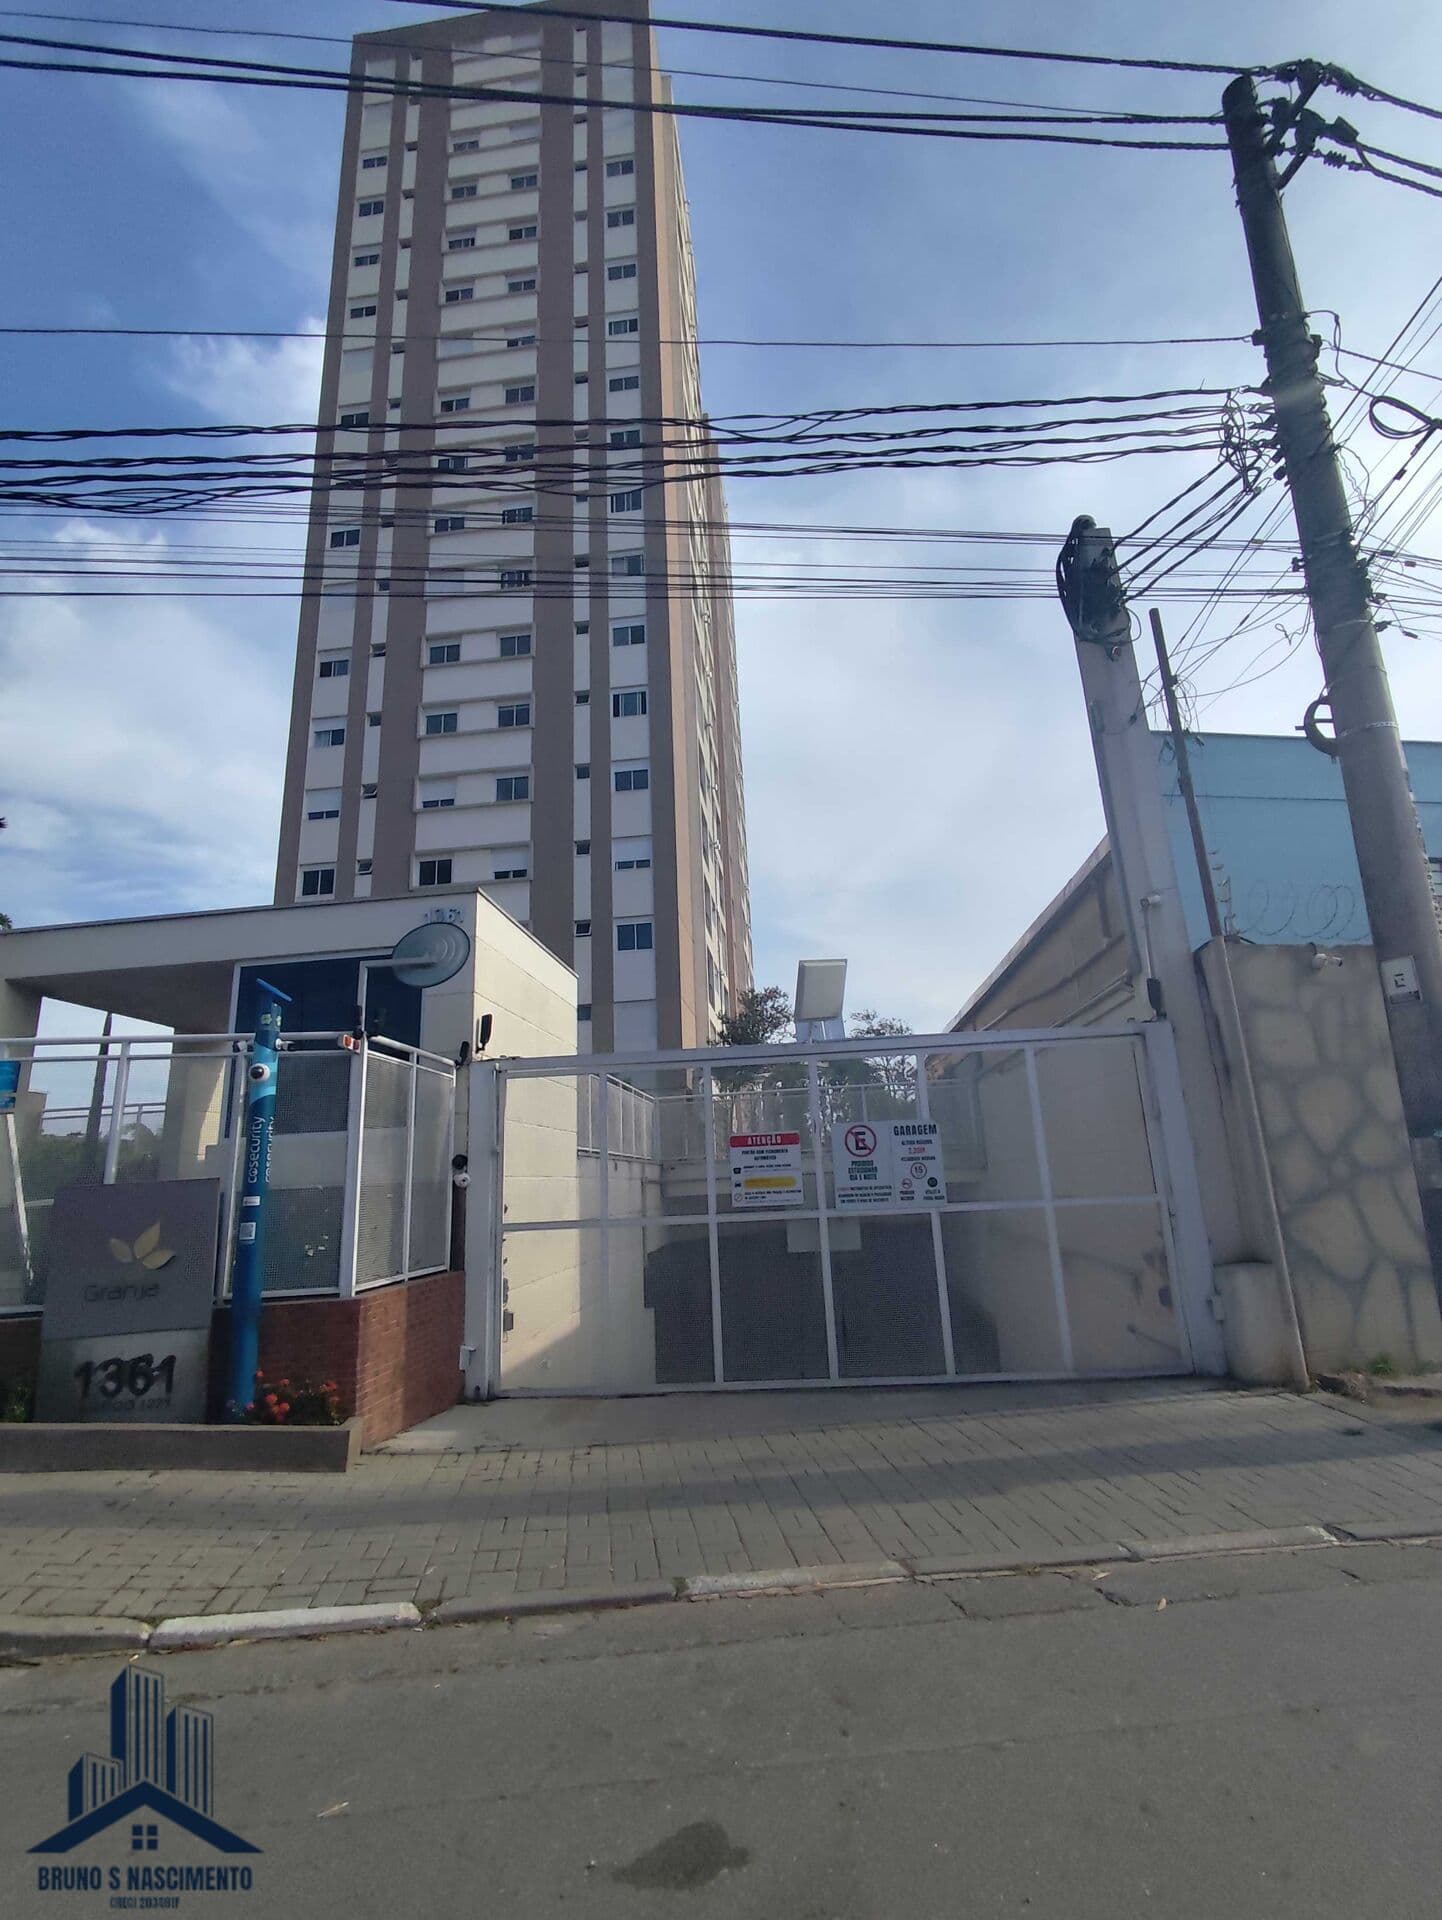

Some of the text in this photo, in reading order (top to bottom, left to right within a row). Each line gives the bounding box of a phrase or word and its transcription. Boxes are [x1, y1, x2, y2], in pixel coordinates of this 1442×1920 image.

[893, 1124, 938, 1137] GARAGEM
[747, 1135, 782, 1147] ATENÇÃO
[247, 1115, 266, 1184] cosecurity
[914, 1166, 923, 1175] 15
[73, 1353, 177, 1399] 1361
